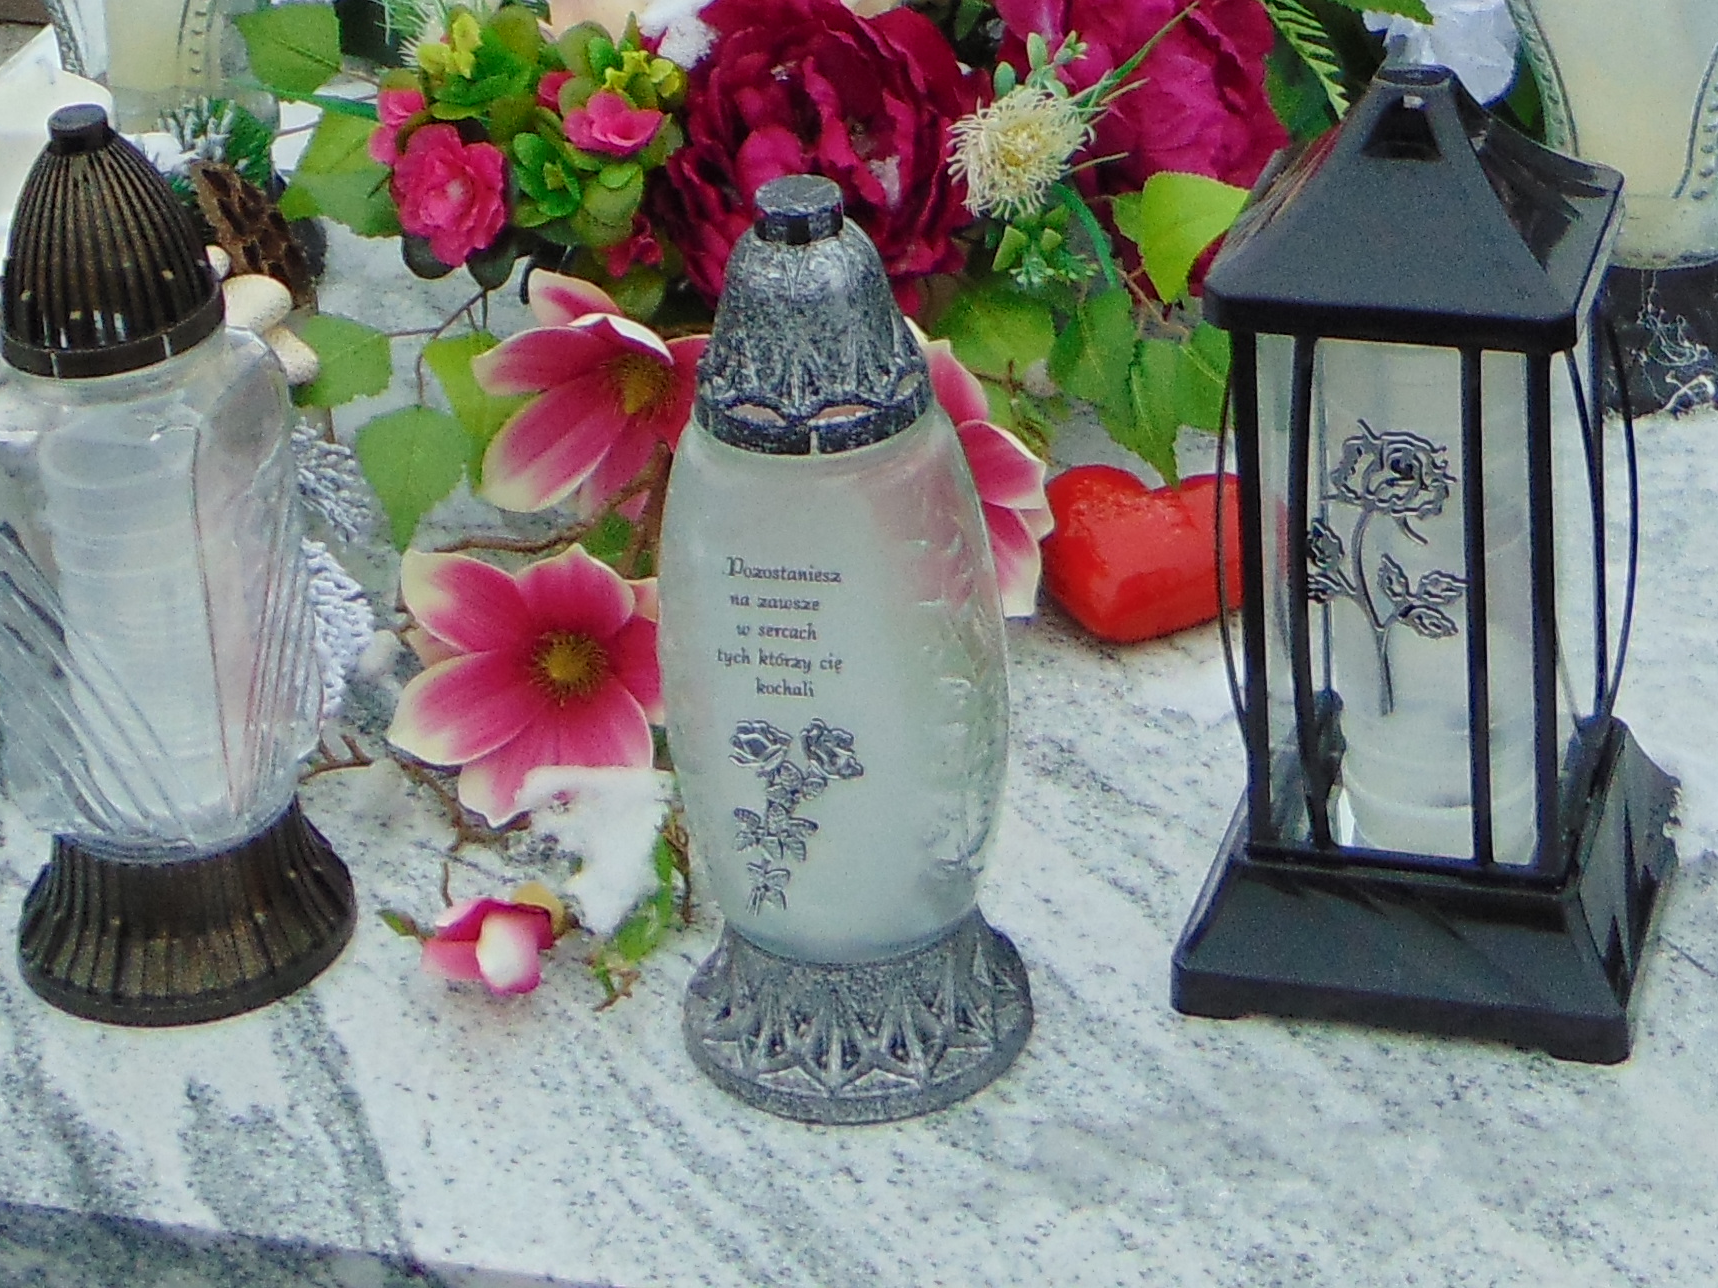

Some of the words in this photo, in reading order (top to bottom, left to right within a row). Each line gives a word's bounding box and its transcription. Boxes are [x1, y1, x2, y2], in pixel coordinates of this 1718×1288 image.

[723, 555, 843, 584] Pozostaniesz
[729, 592, 751, 608] na
[756, 595, 821, 612] zawsze
[736, 623, 751, 637] w
[758, 622, 818, 641] sercach
[717, 646, 751, 668] tych
[758, 647, 812, 675] którzy
[819, 651, 844, 675] cię
[755, 676, 815, 698] kochali
